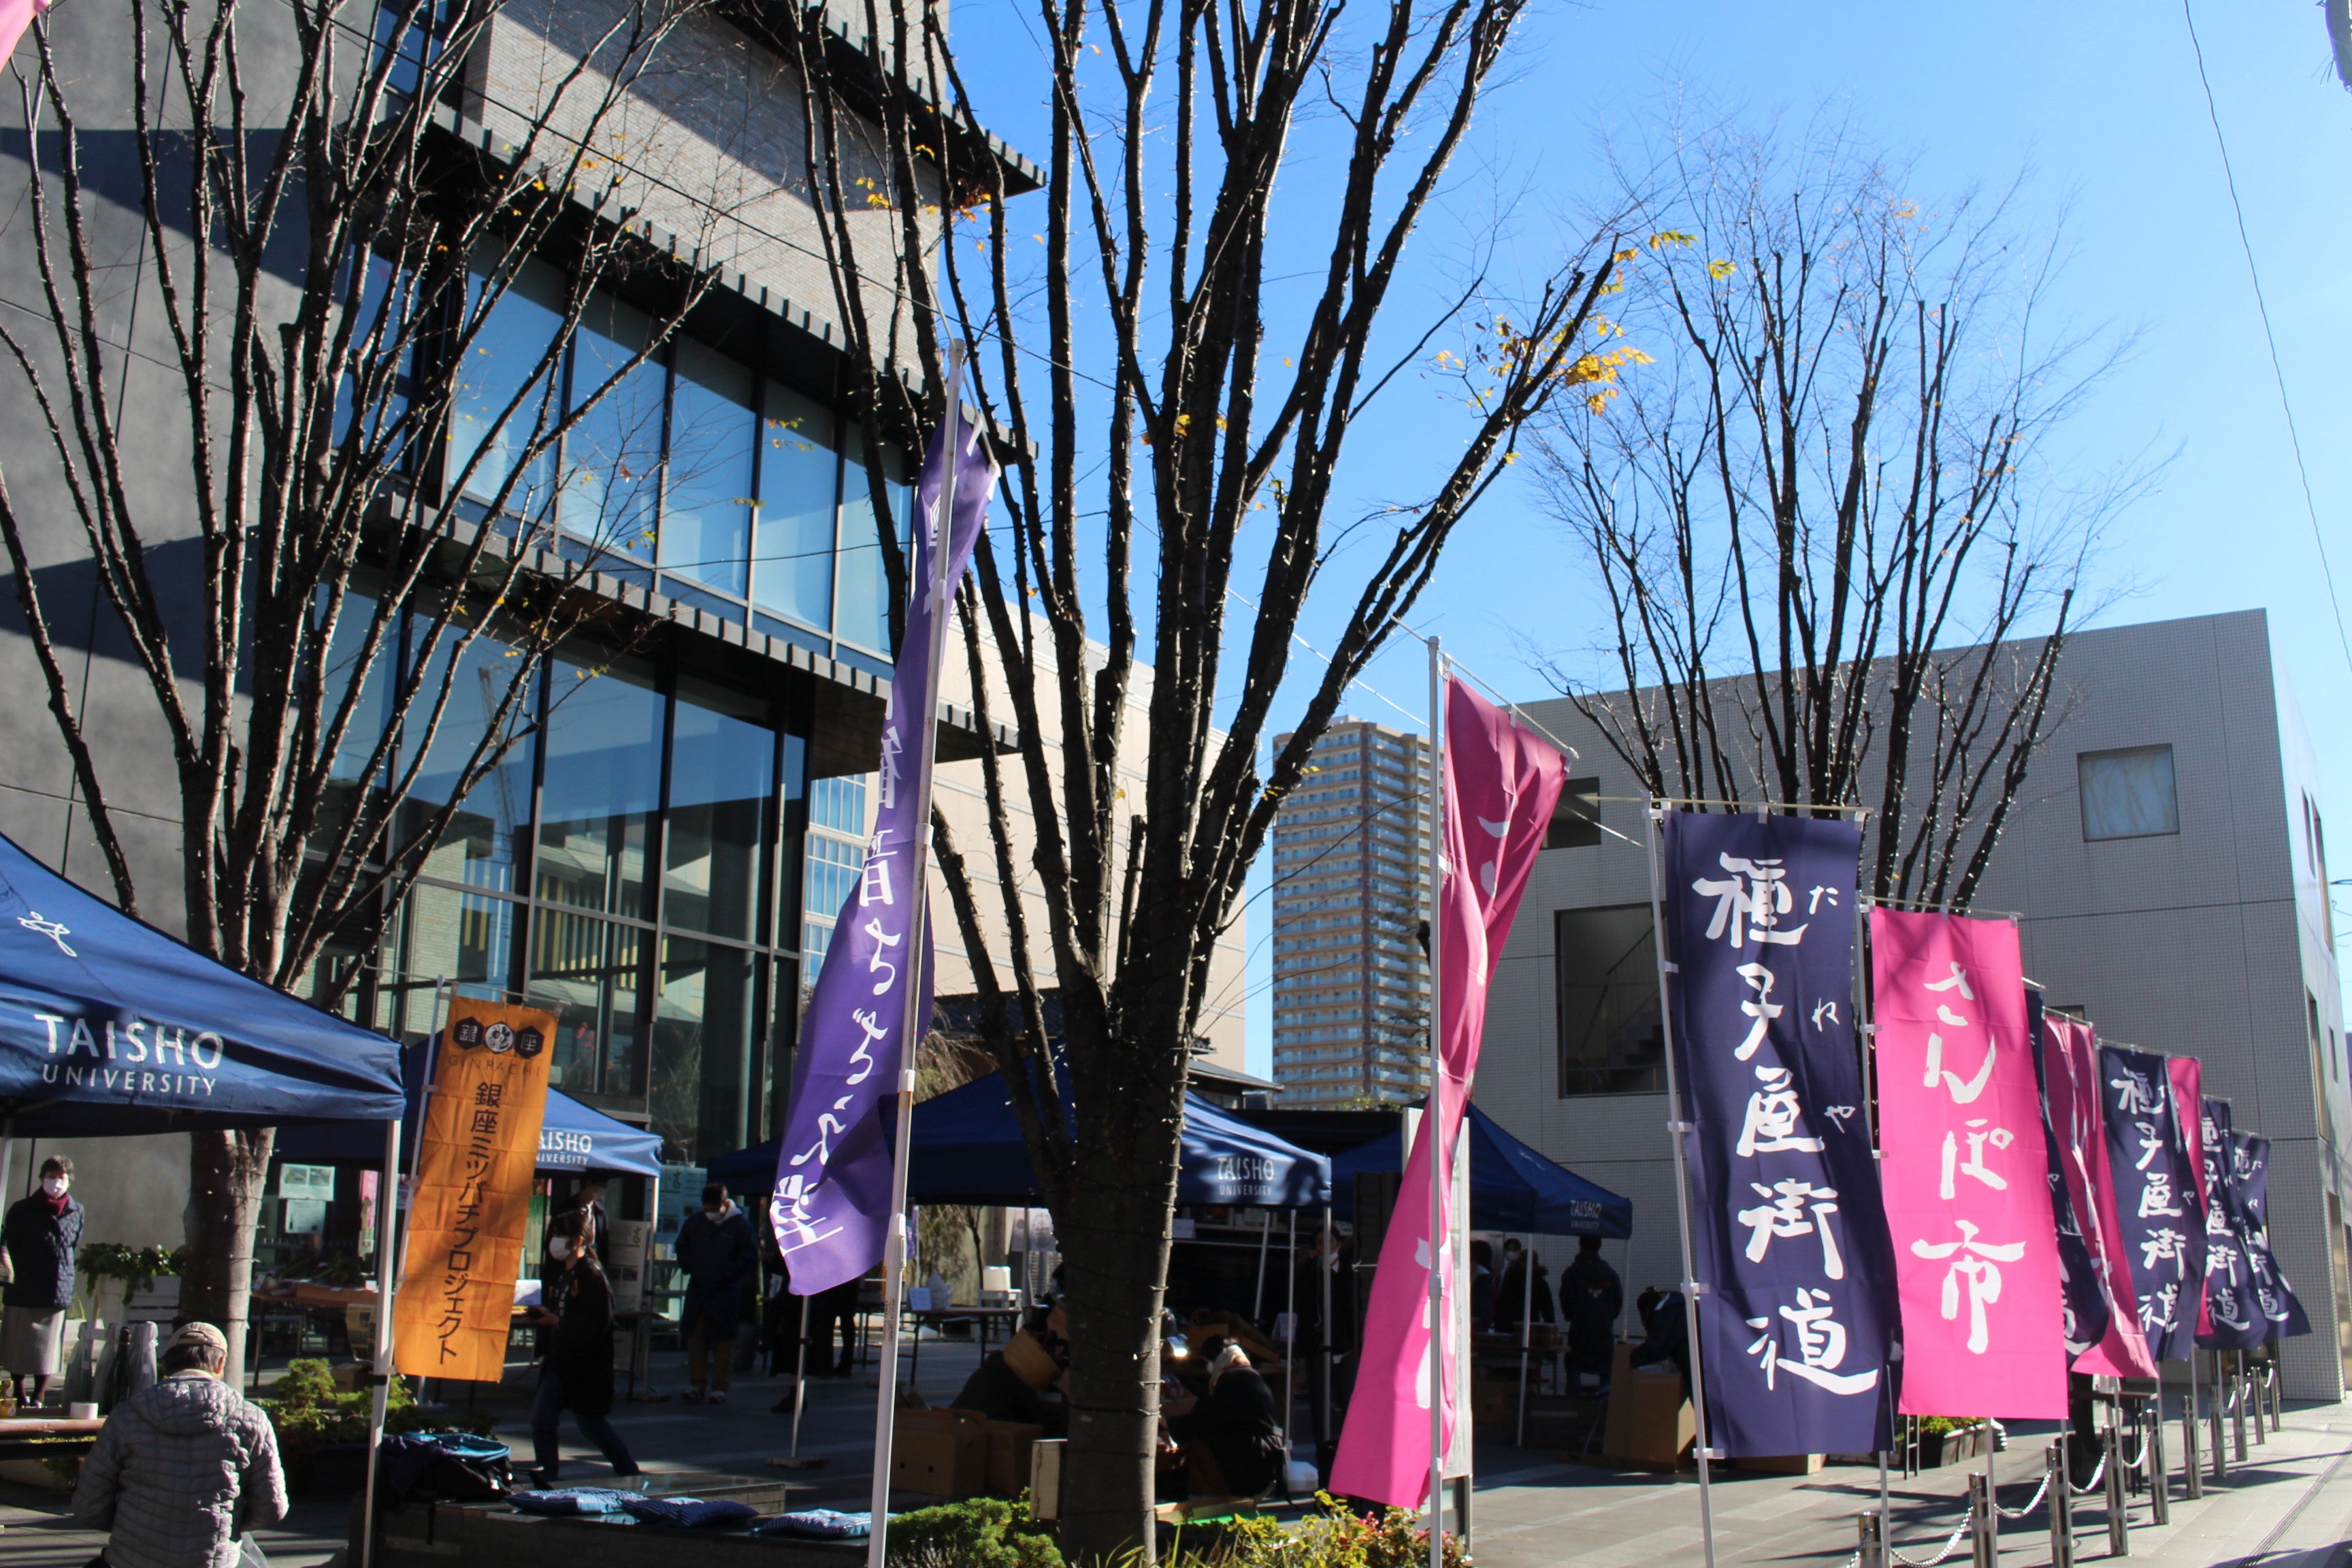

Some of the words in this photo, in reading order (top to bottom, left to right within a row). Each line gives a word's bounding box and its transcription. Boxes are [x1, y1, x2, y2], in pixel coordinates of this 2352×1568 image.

[34, 1013, 225, 1070] TAISHO
[42, 1063, 216, 1096] UNIVERSITY
[448, 1056, 540, 1077] GINPACHI
[1693, 851, 1879, 1396] 種子屋街道
[539, 1131, 592, 1153] AISHO
[536, 1153, 589, 1166] IVERSITY
[1218, 1158, 1275, 1181] TAISHO
[1911, 961, 2027, 1355] さんぽ市
[1220, 1184, 1273, 1196] UNIVERSITY
[438, 1081, 503, 1365] 銀座ミツバチプロジェクト
